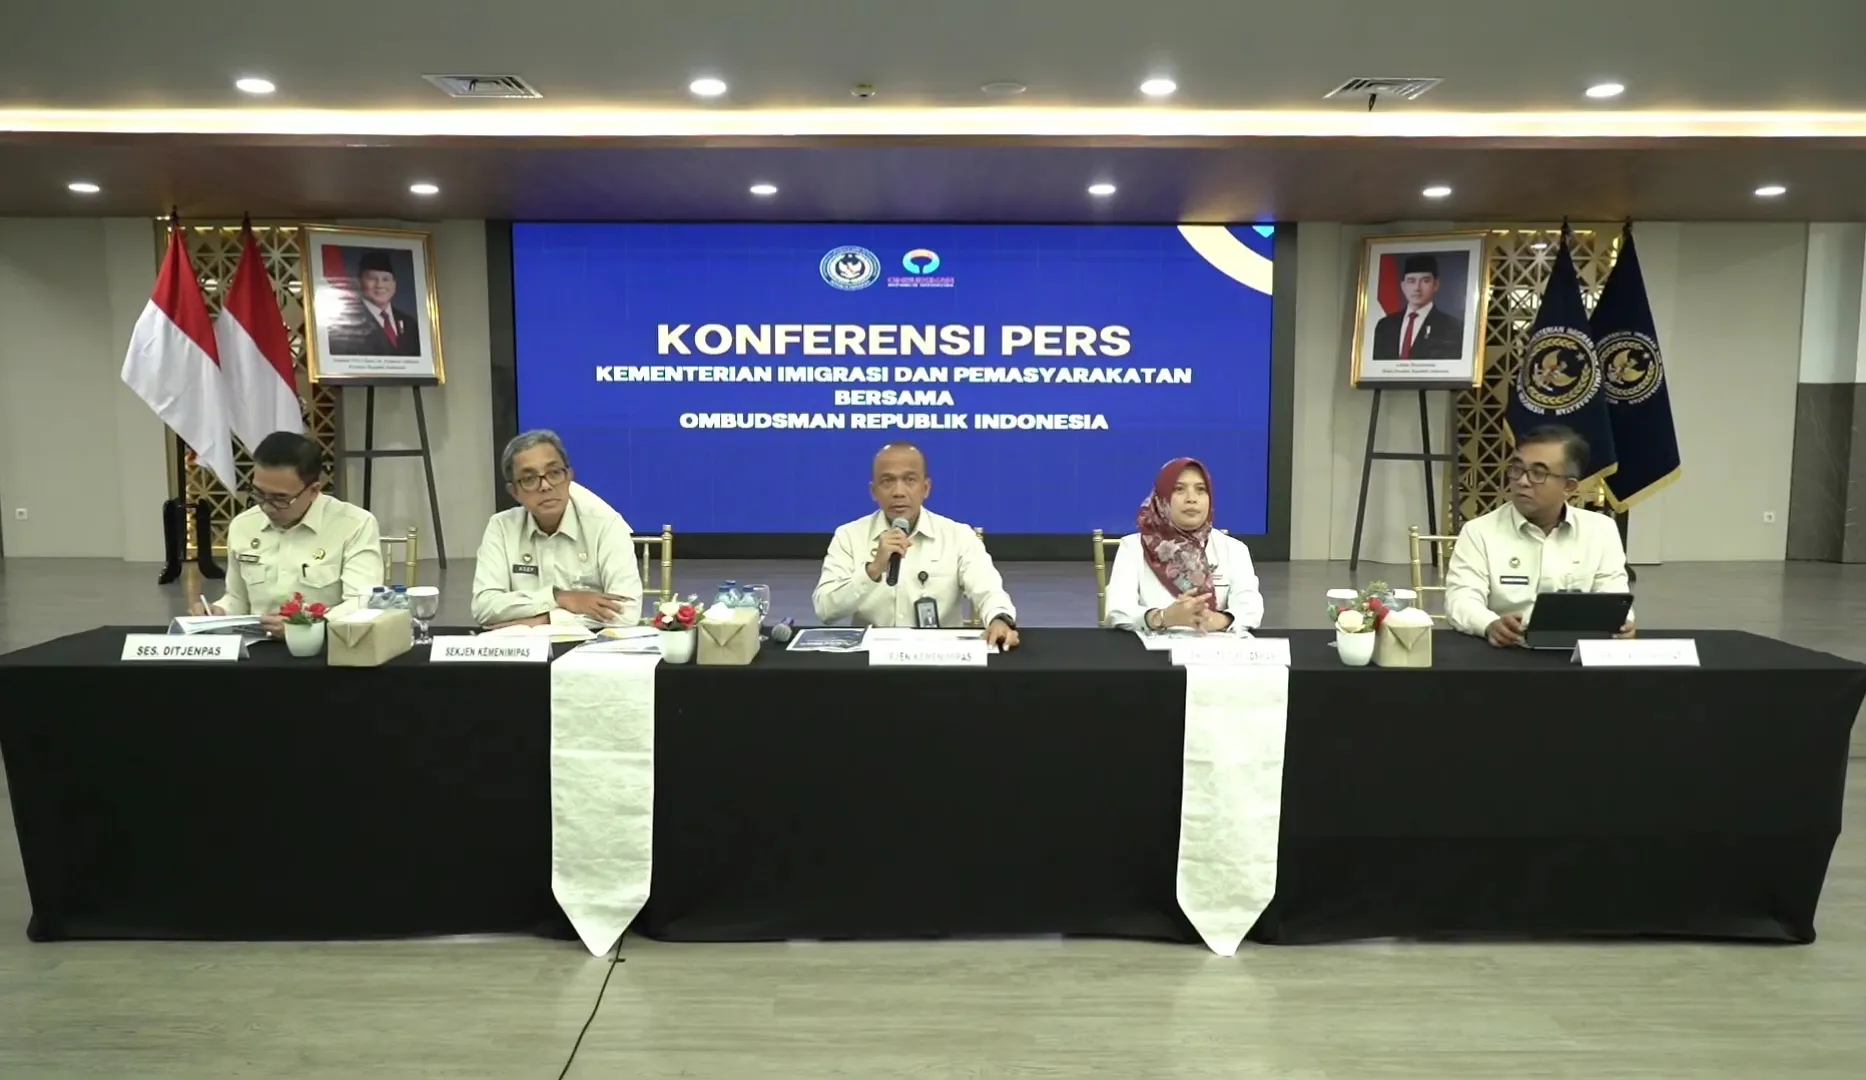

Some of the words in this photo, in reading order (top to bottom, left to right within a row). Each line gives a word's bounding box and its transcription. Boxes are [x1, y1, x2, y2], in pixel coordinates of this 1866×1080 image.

[657, 323, 985, 356] KONFERENSI
[1001, 325, 1131, 357] PERS
[596, 365, 773, 382] KEMENTERIAN
[777, 366, 889, 383] IMIGRASI
[894, 366, 949, 383] DAN
[953, 366, 1193, 384] PEMASYARAKATAN
[834, 389, 955, 406] BERSAMA
[679, 412, 846, 429] OMBUDSMAN
[850, 413, 969, 429] REPUBLIK
[974, 413, 1109, 430] INDONESIA
[136, 646, 159, 657] SES.
[163, 646, 222, 657] DITJENPAS
[445, 646, 476, 658] SEKJEN
[477, 646, 531, 658] KEMENIMIPAS
